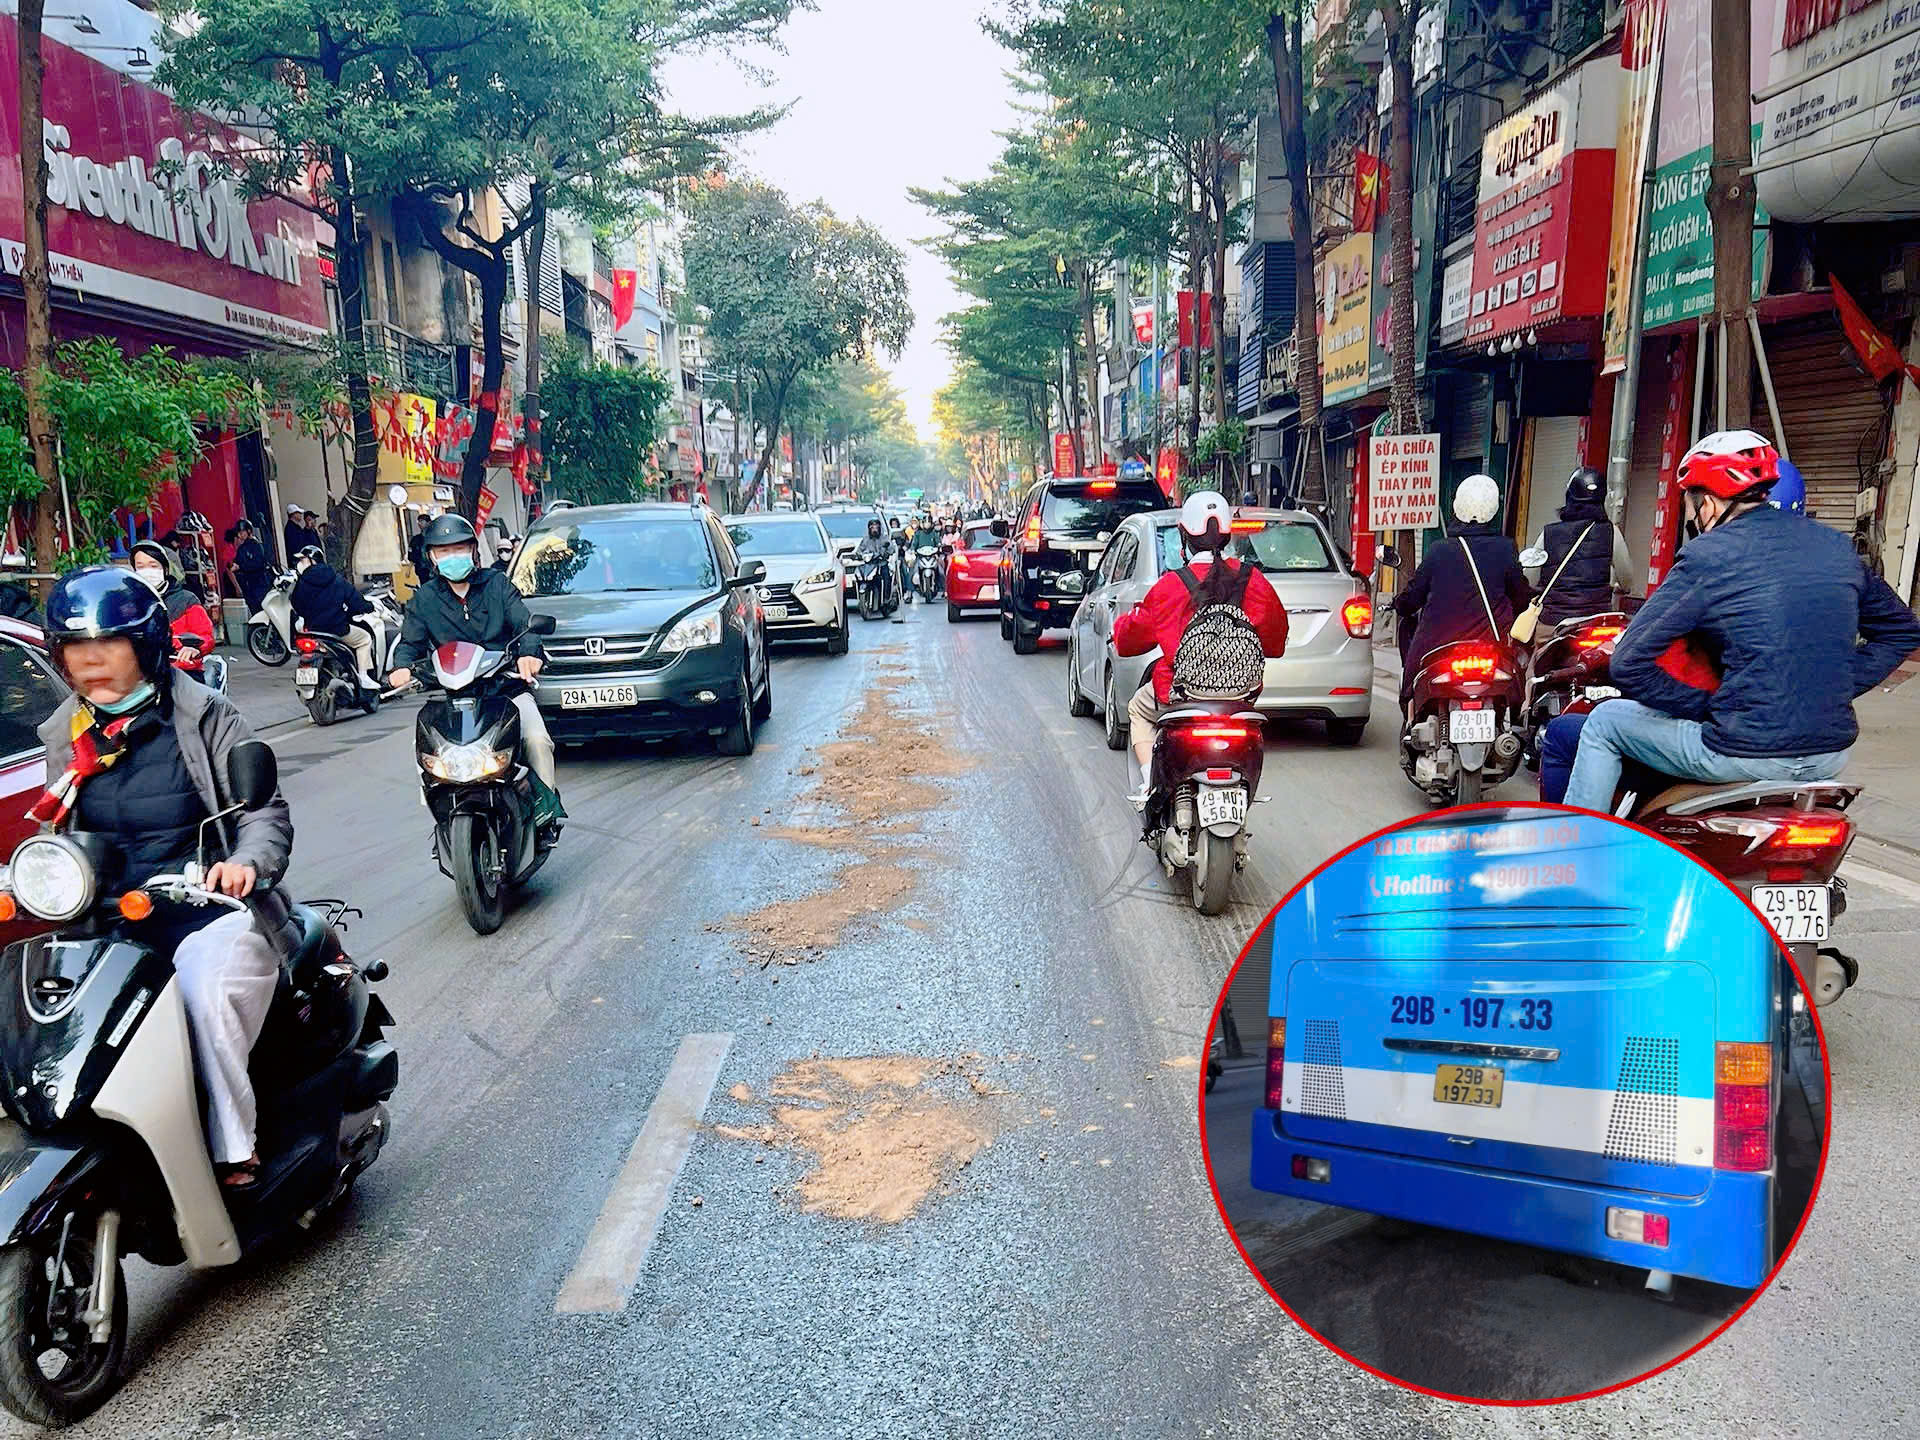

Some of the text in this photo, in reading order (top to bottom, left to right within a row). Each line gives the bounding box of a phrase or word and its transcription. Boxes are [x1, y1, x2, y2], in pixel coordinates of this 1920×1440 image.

[1375, 439, 1435, 456] SỬA CHỮA
[1381, 458, 1428, 474] ÉP KÍNH
[1378, 476, 1432, 491] THAY PIN
[1373, 492, 1436, 509] THAY MÀN
[1375, 510, 1433, 526] LẤY NGAY
[563, 688, 633, 705] 29A-142.66
[1395, 837, 1412, 855] XE
[1384, 874, 1456, 897] Hotline
[1765, 889, 1818, 913] 29-B2
[1766, 915, 1824, 938] 27.76
[1391, 995, 1435, 1025] 29B
[1454, 1067, 1484, 1085] 29B
[1443, 1085, 1495, 1105] 197.33
